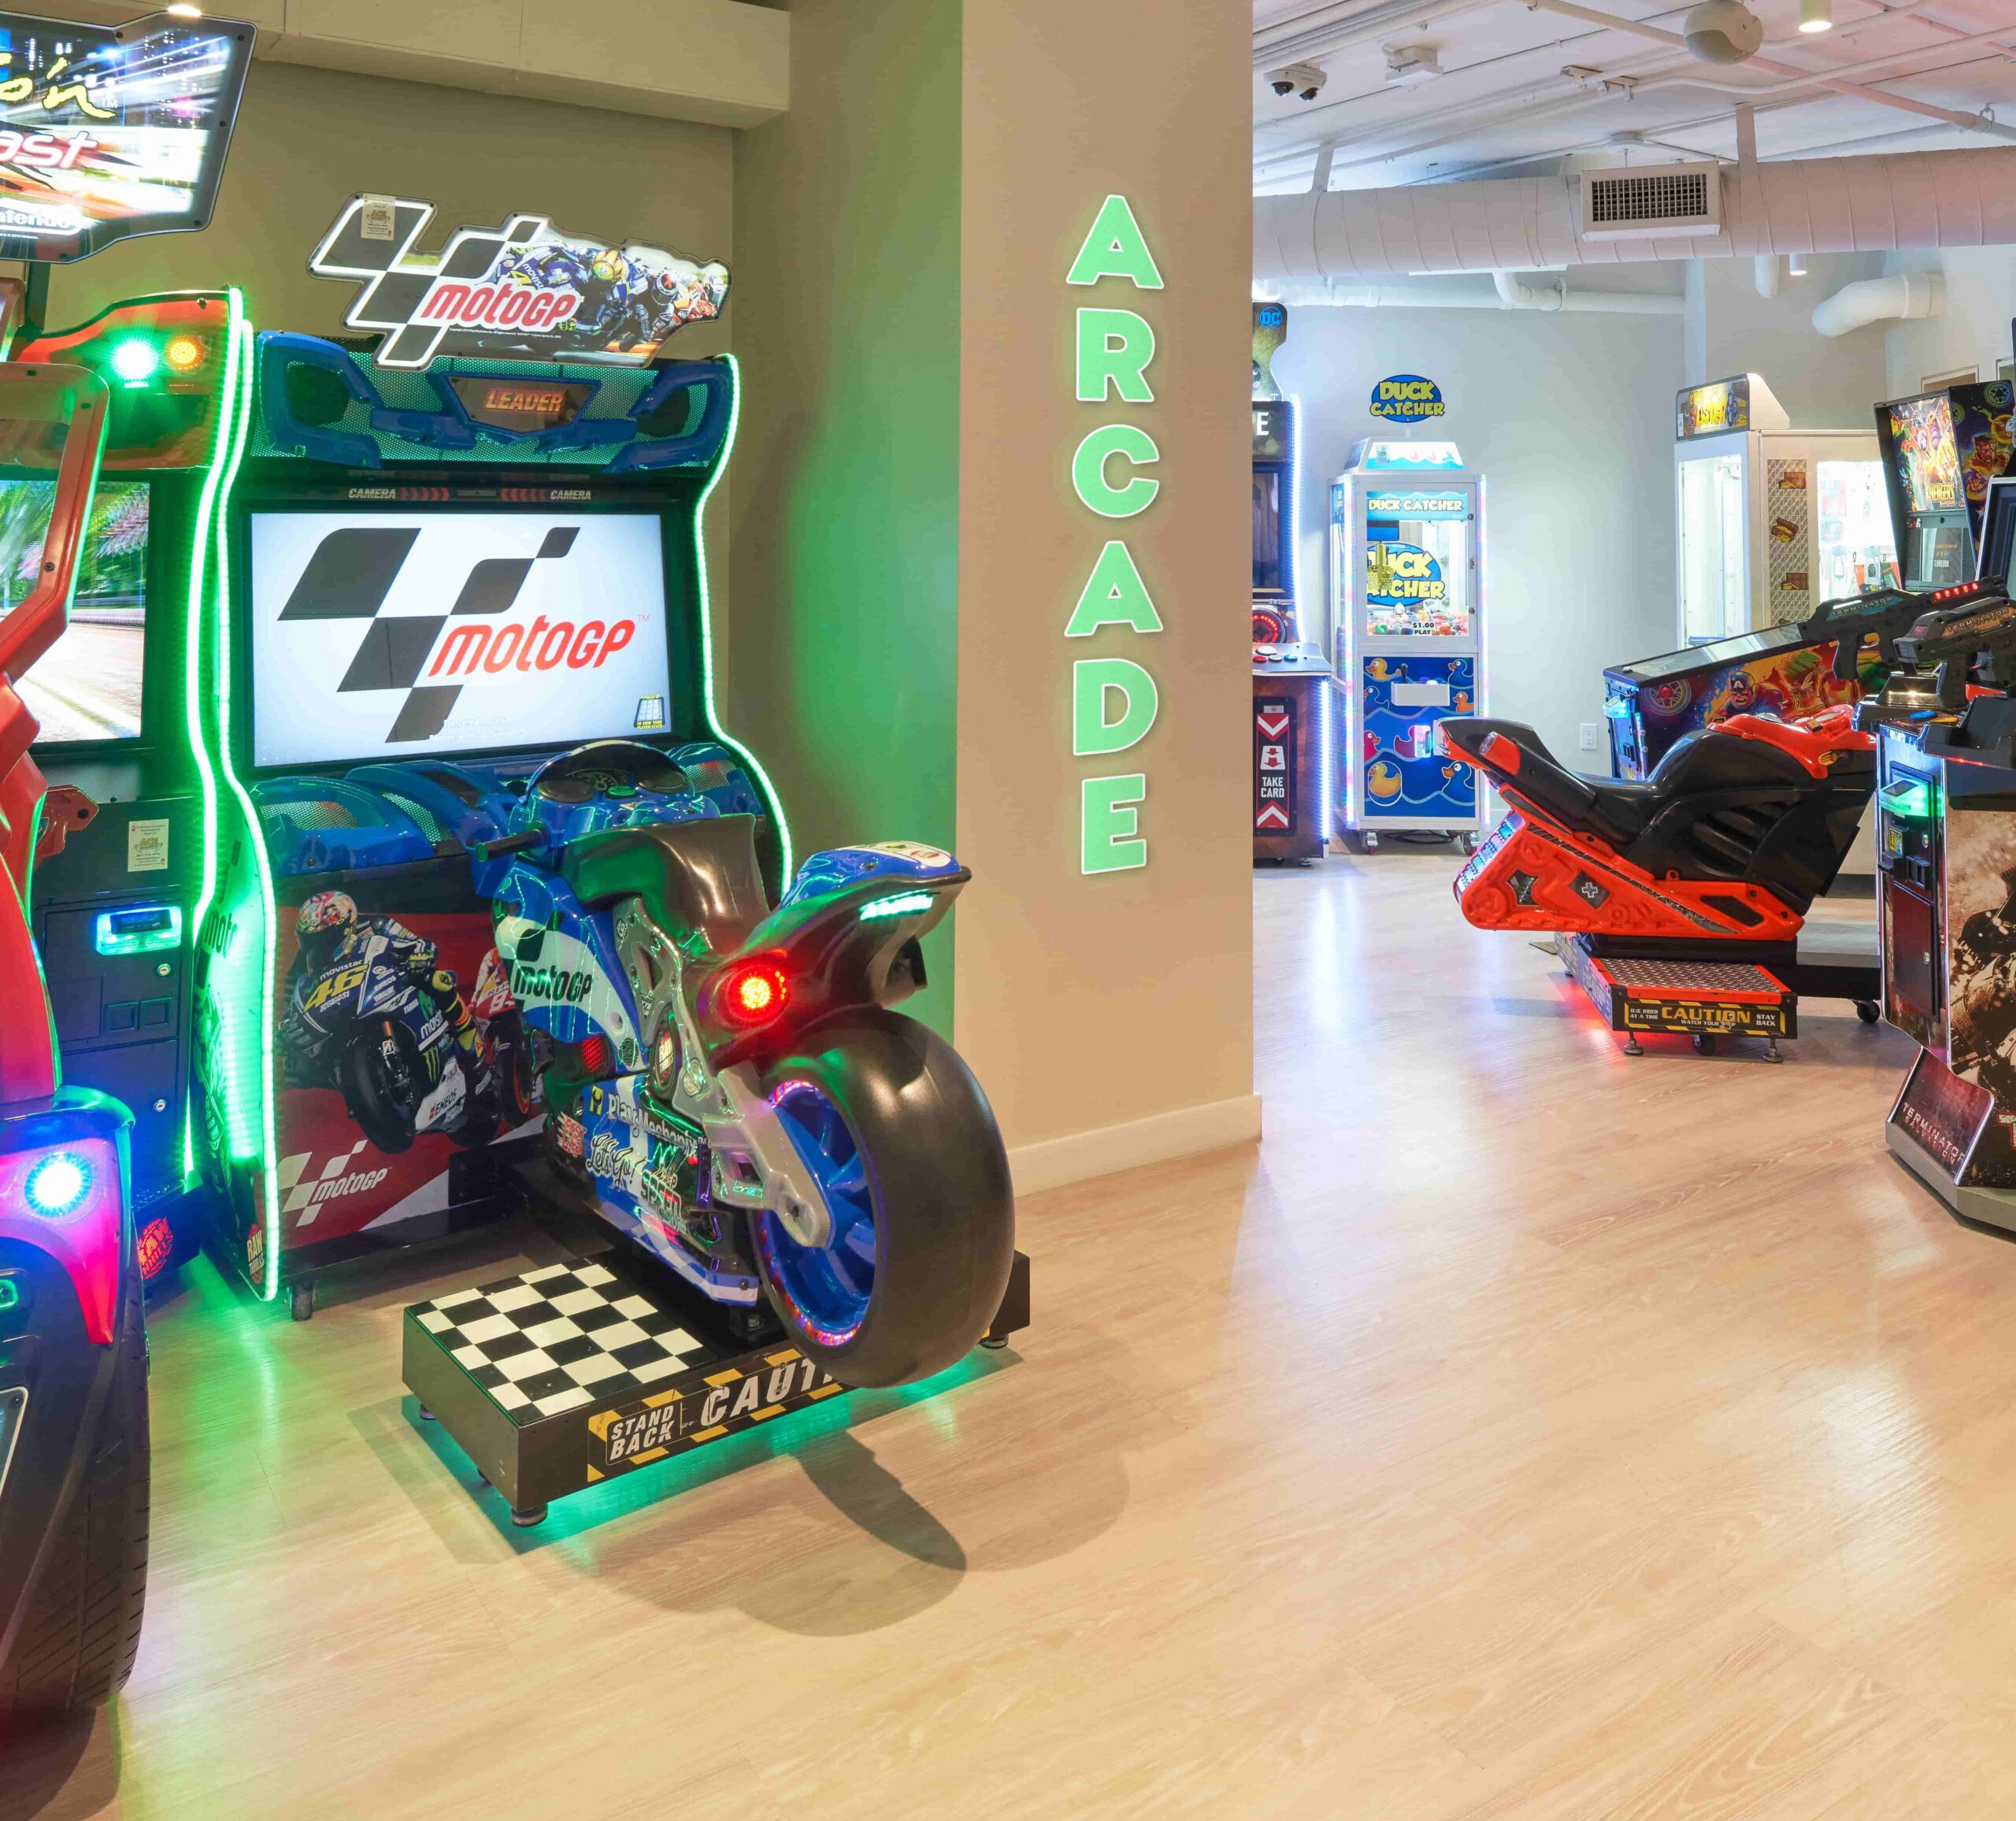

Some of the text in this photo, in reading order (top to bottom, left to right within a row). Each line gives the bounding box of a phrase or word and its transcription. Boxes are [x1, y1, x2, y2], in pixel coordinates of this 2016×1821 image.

[1262, 312, 1282, 325] DC
[485, 388, 566, 414] LEADER
[1379, 380, 1435, 401] DUCK
[1369, 402, 1445, 417] CATCHER
[348, 488, 395, 499] CAMERA
[550, 490, 591, 500] CAMERA
[1367, 498, 1463, 512] DUCK CATCHER
[1065, 195, 1164, 874] ARCADE
[1947, 607, 2009, 631] TERMINATOR
[1261, 788, 1284, 798] CARD
[1262, 777, 1283, 787] TAKE
[320, 959, 363, 981] movistar
[303, 962, 369, 1013] 46
[1662, 1007, 1751, 1023] CAUTION
[1905, 1115, 1956, 1165] SALVATION
[246, 1229, 263, 1263] RAW
[699, 1358, 833, 1427] CAUT
[610, 1405, 675, 1441] STAND
[610, 1422, 674, 1461] BACK
